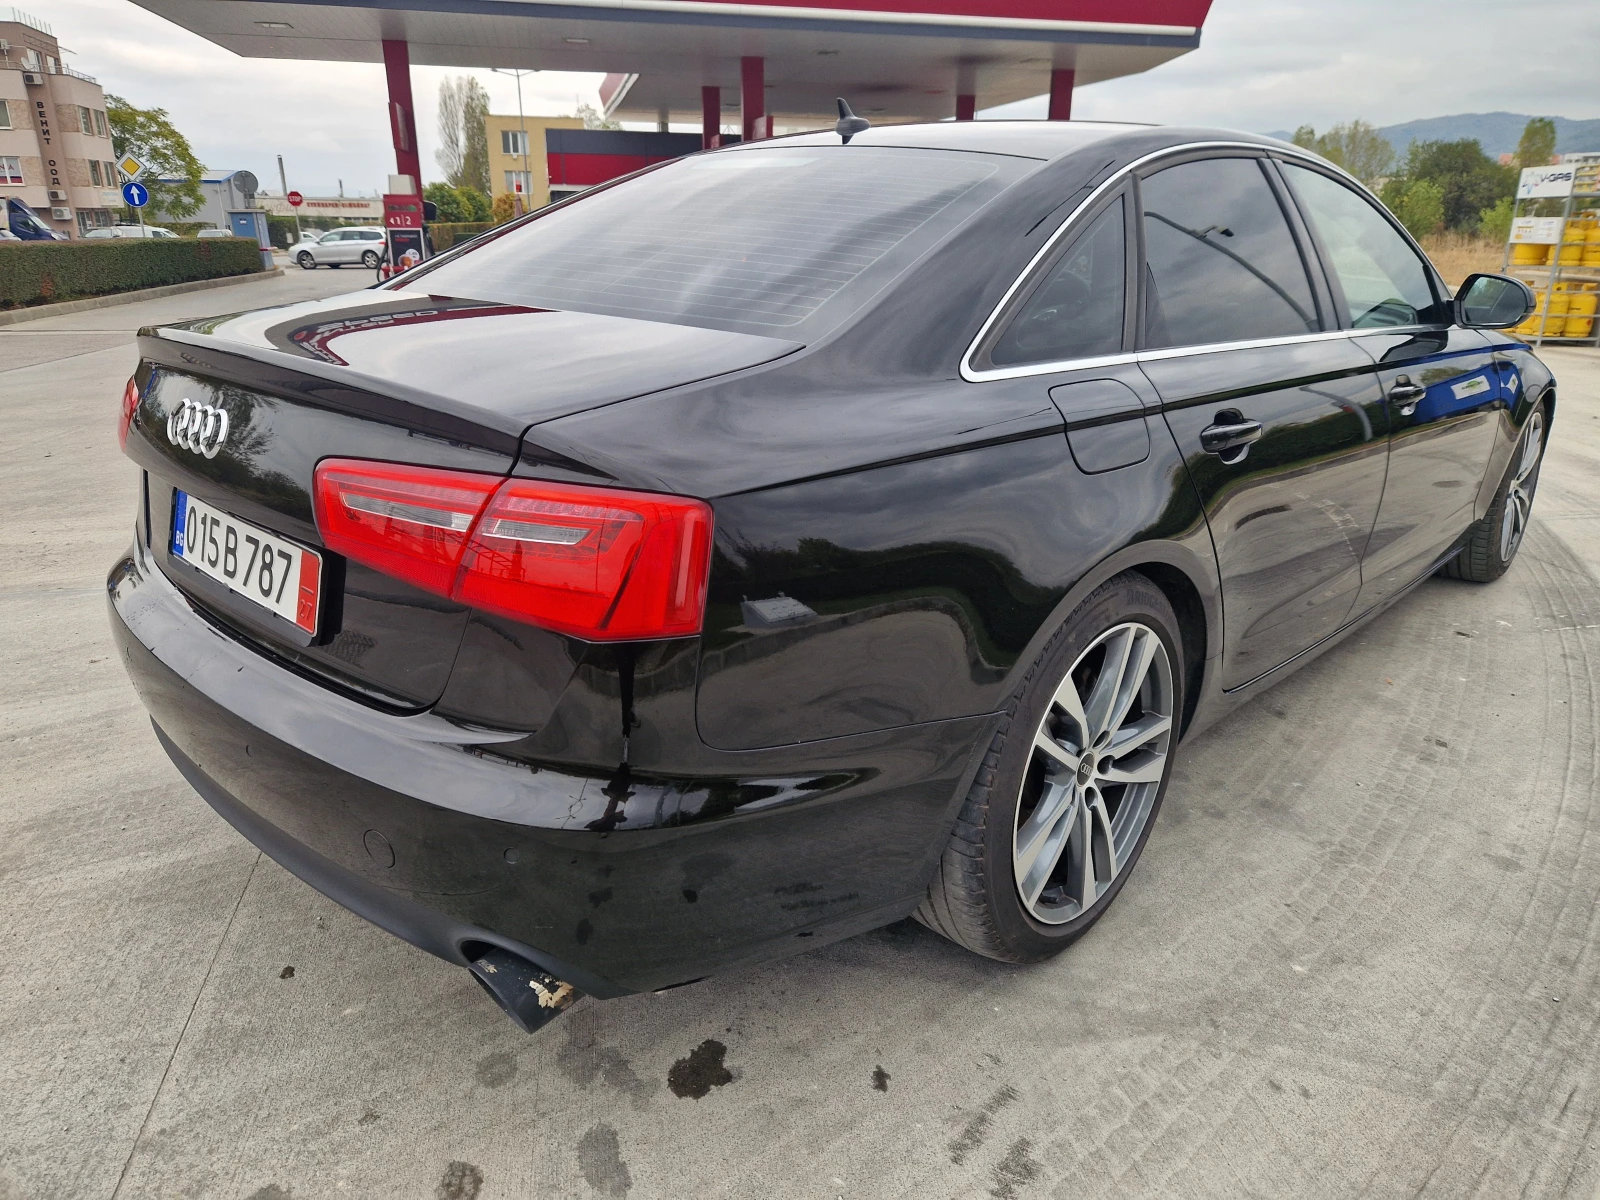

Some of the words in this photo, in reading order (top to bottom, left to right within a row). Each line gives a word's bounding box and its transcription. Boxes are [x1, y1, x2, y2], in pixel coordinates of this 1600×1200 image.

[37, 101, 51, 145] ВЕНИТ
[48, 159, 61, 186] ООД
[1541, 172, 1572, 183] V-GAS
[288, 195, 302, 203] STOP
[176, 531, 184, 547] BG
[186, 505, 293, 604] 015B787
